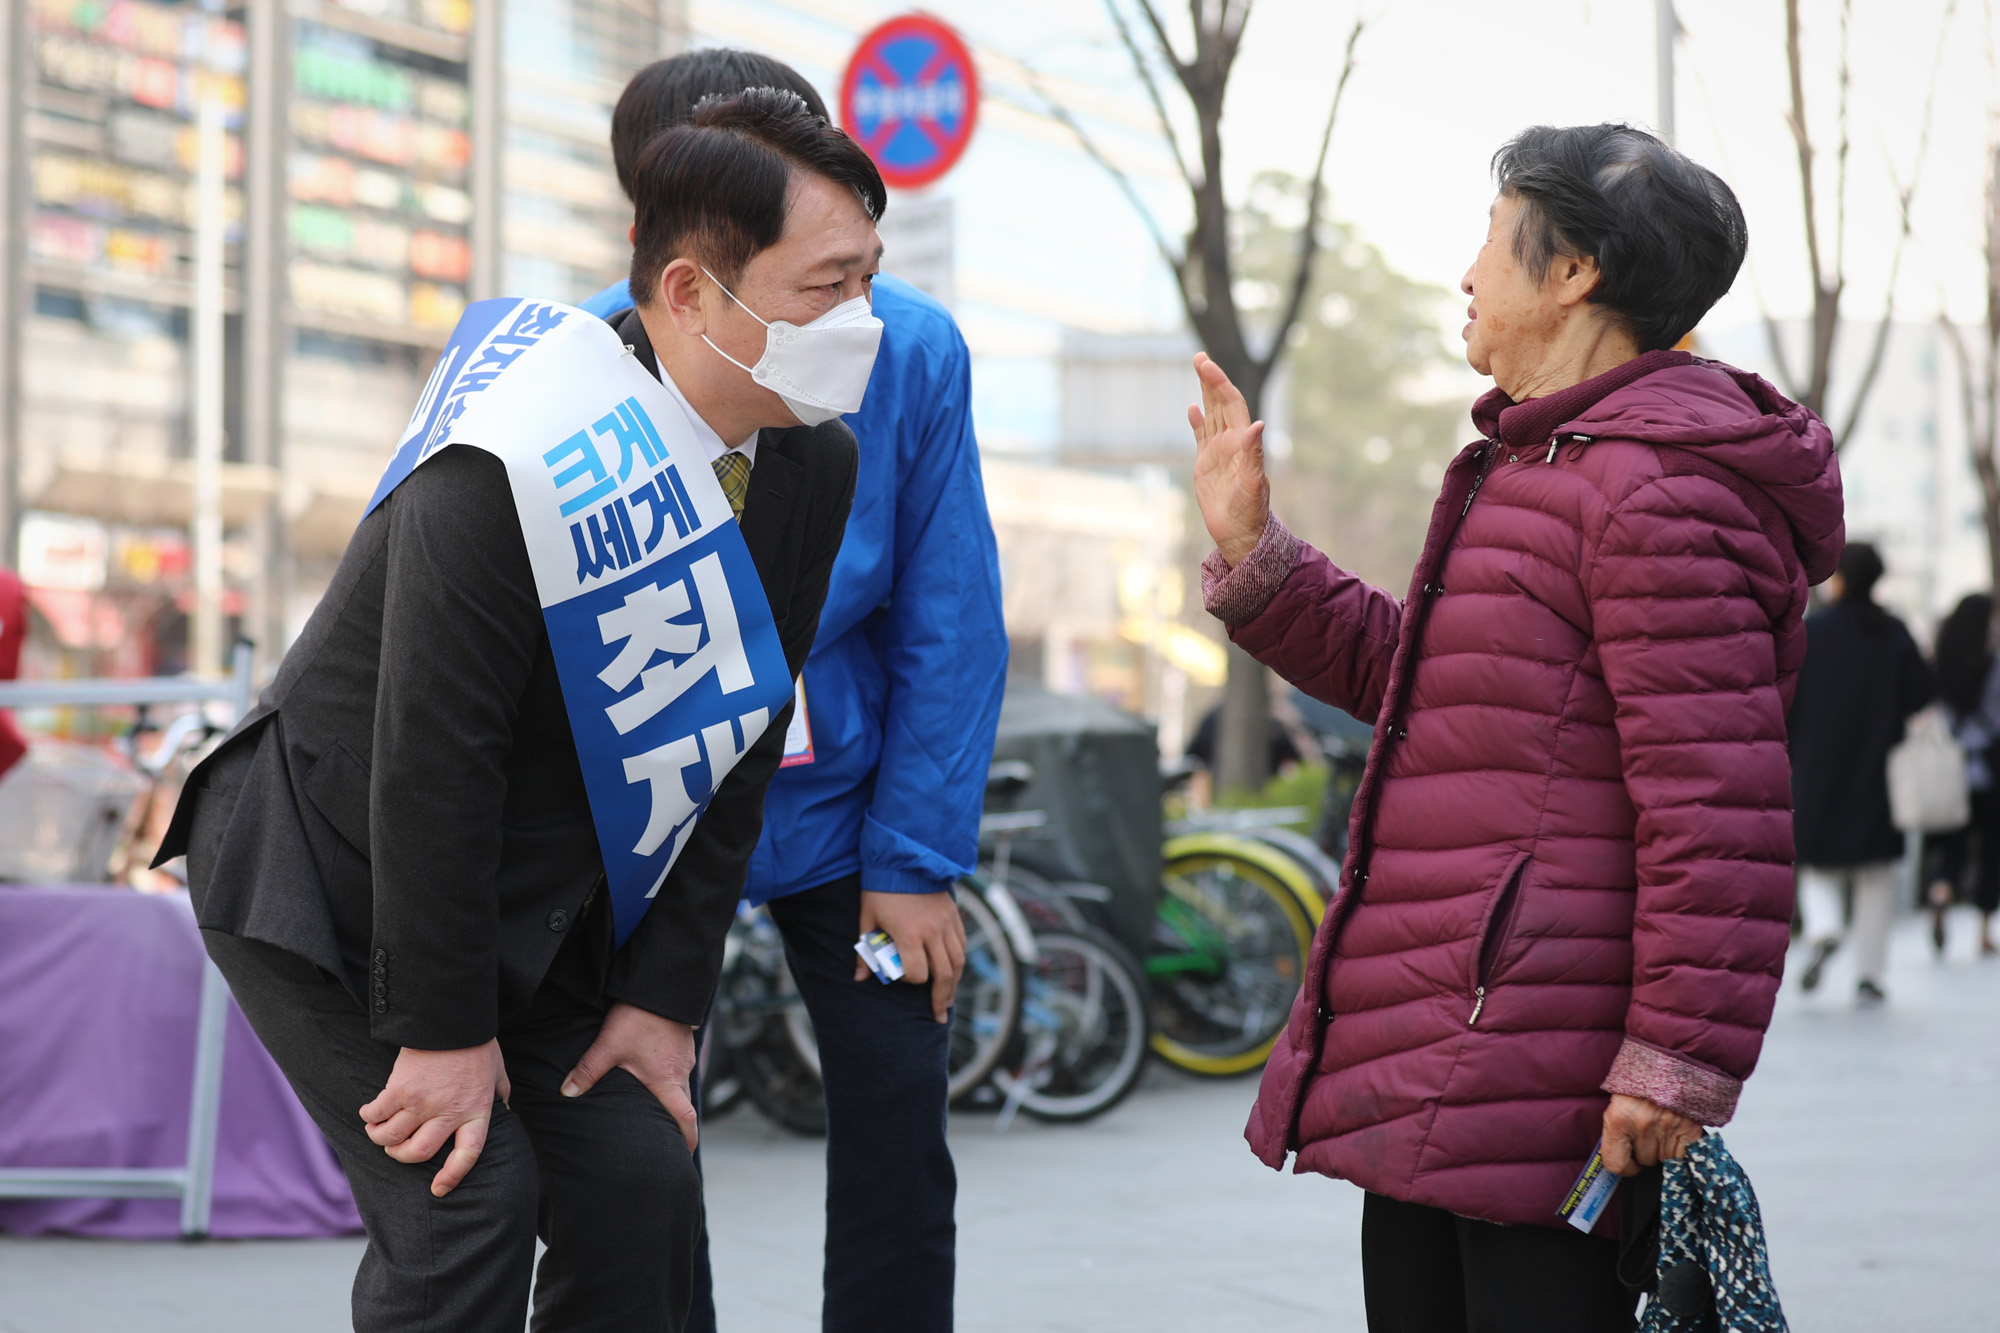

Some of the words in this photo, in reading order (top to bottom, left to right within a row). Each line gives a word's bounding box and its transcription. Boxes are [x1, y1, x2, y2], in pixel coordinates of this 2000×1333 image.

[544, 397, 669, 517] 크게
[570, 464, 701, 585] 쎄게
[597, 551, 769, 898] 최재
